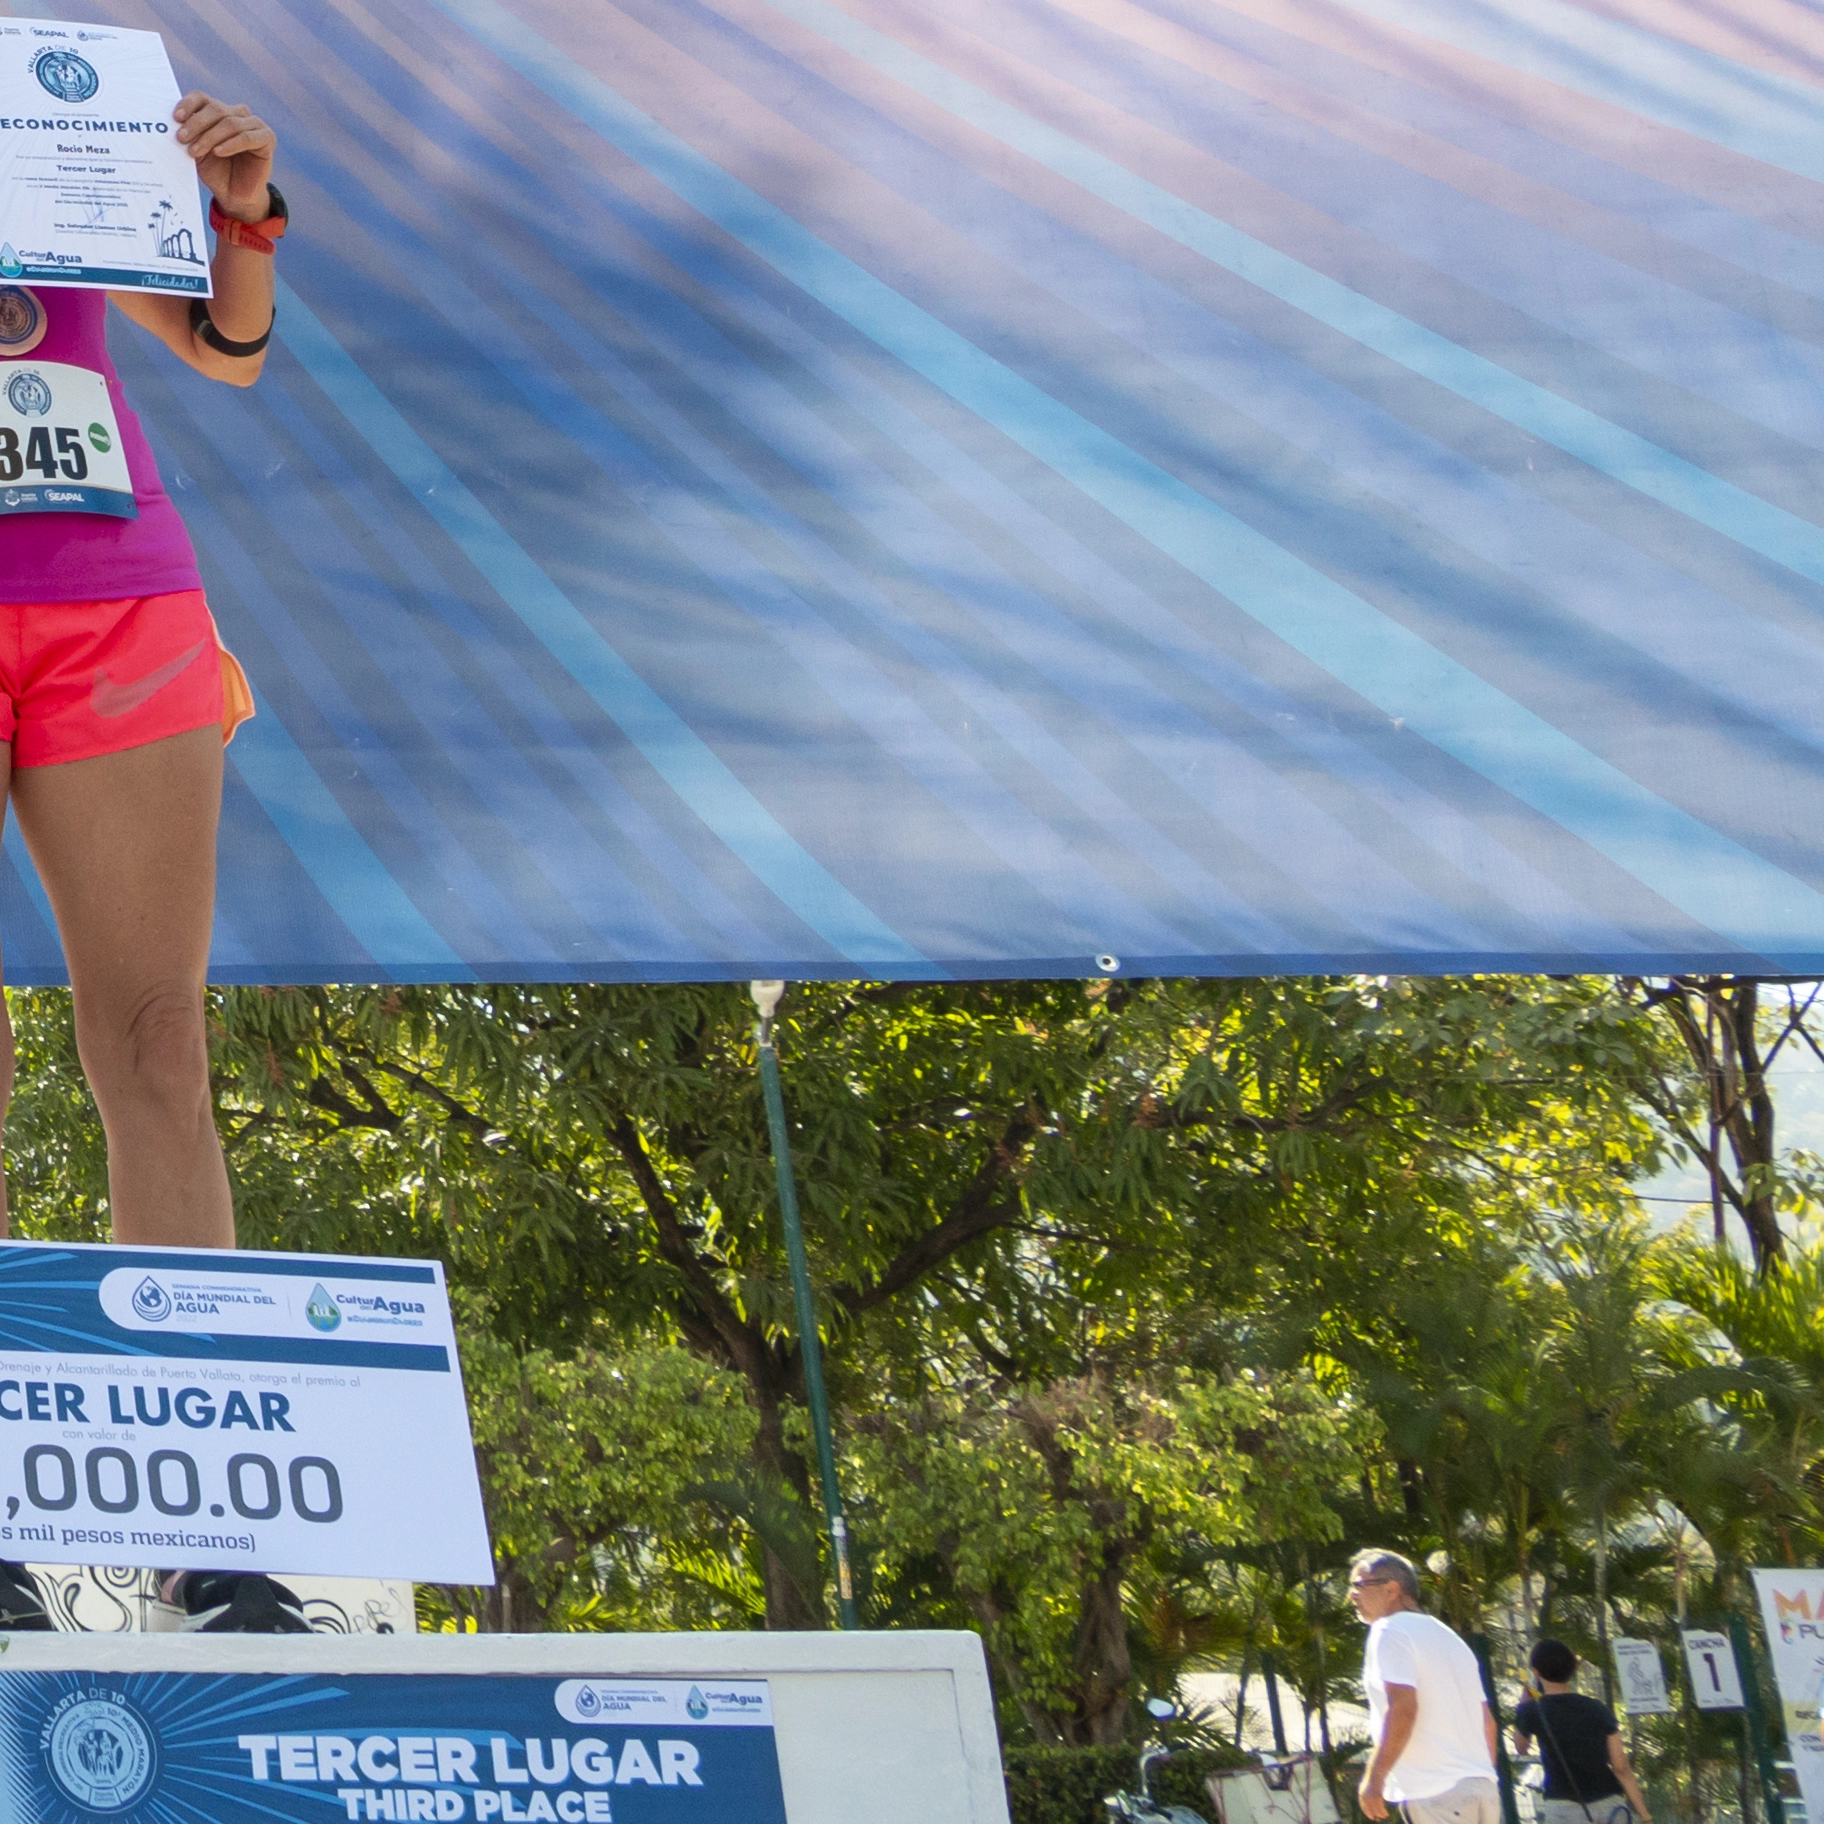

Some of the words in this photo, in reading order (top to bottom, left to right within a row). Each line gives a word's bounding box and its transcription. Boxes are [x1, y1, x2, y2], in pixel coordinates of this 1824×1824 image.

[33, 29, 70, 39] SEAPAL
[85, 144, 112, 155] Meza
[56, 164, 88, 173] Tercer
[89, 165, 117, 175] Lugar
[48, 491, 86, 503] SEAPAL
[174, 1291, 195, 1302] DÍA
[197, 1293, 251, 1304] MUNDIAL
[253, 1295, 277, 1305] DEL
[176, 1302, 220, 1315] AGUA
[56, 1362, 138, 1378] Alcantarillado
[160, 1367, 197, 1381] Puerto
[249, 1372, 289, 1387] otorga
[306, 1375, 348, 1389] premio
[108, 1384, 297, 1433] LUGAR
[19, 1523, 55, 1542] mil
[61, 1527, 125, 1548] pesos
[130, 1529, 257, 1552] mexicanos)
[1703, 1652, 1722, 1693] 1
[40, 1690, 87, 1750] VALLARTA
[88, 1687, 109, 1700] DE
[111, 1690, 127, 1705] 10
[238, 1734, 480, 1785] TERCER
[491, 1737, 706, 1787] LUGAR
[337, 1788, 464, 1823] THIRD
[472, 1788, 612, 1824] PLACE
